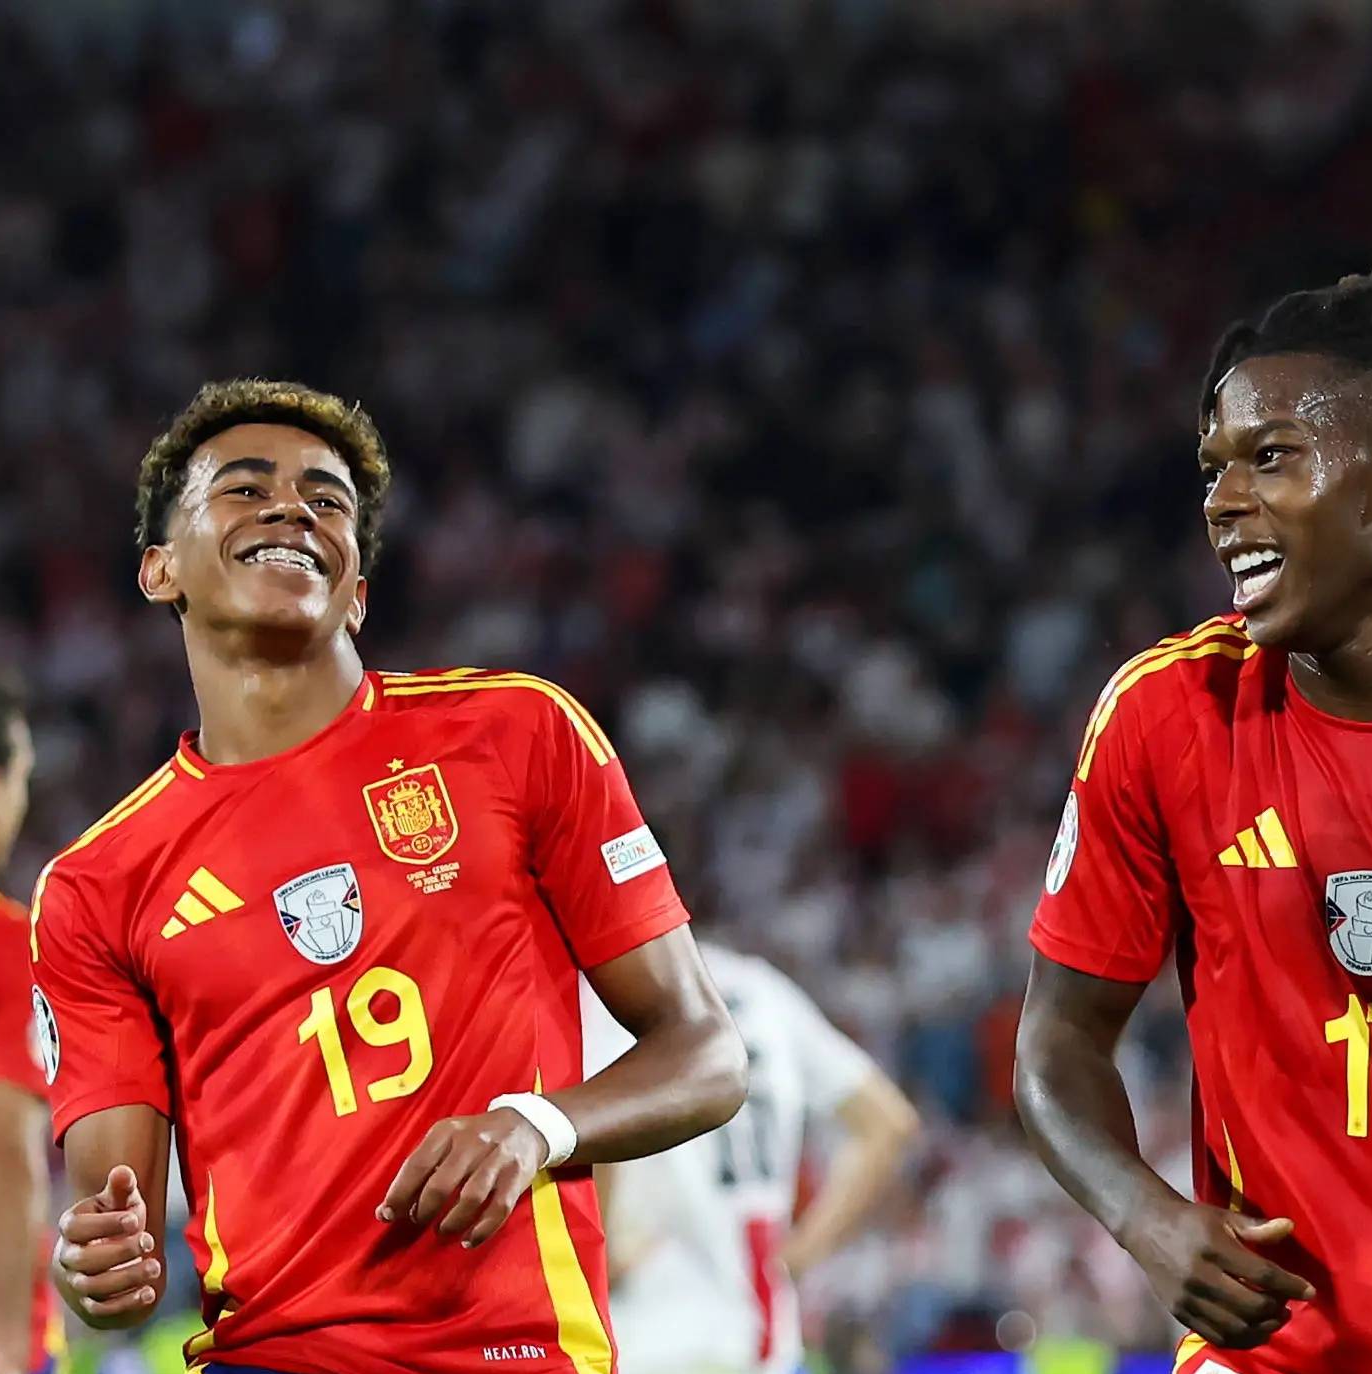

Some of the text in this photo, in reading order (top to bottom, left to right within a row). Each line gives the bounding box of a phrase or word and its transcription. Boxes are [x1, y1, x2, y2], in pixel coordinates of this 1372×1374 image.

[1331, 876, 1349, 884] UEFA
[297, 966, 433, 1117] 19
[483, 1344, 546, 1361] HEAT.RDY
